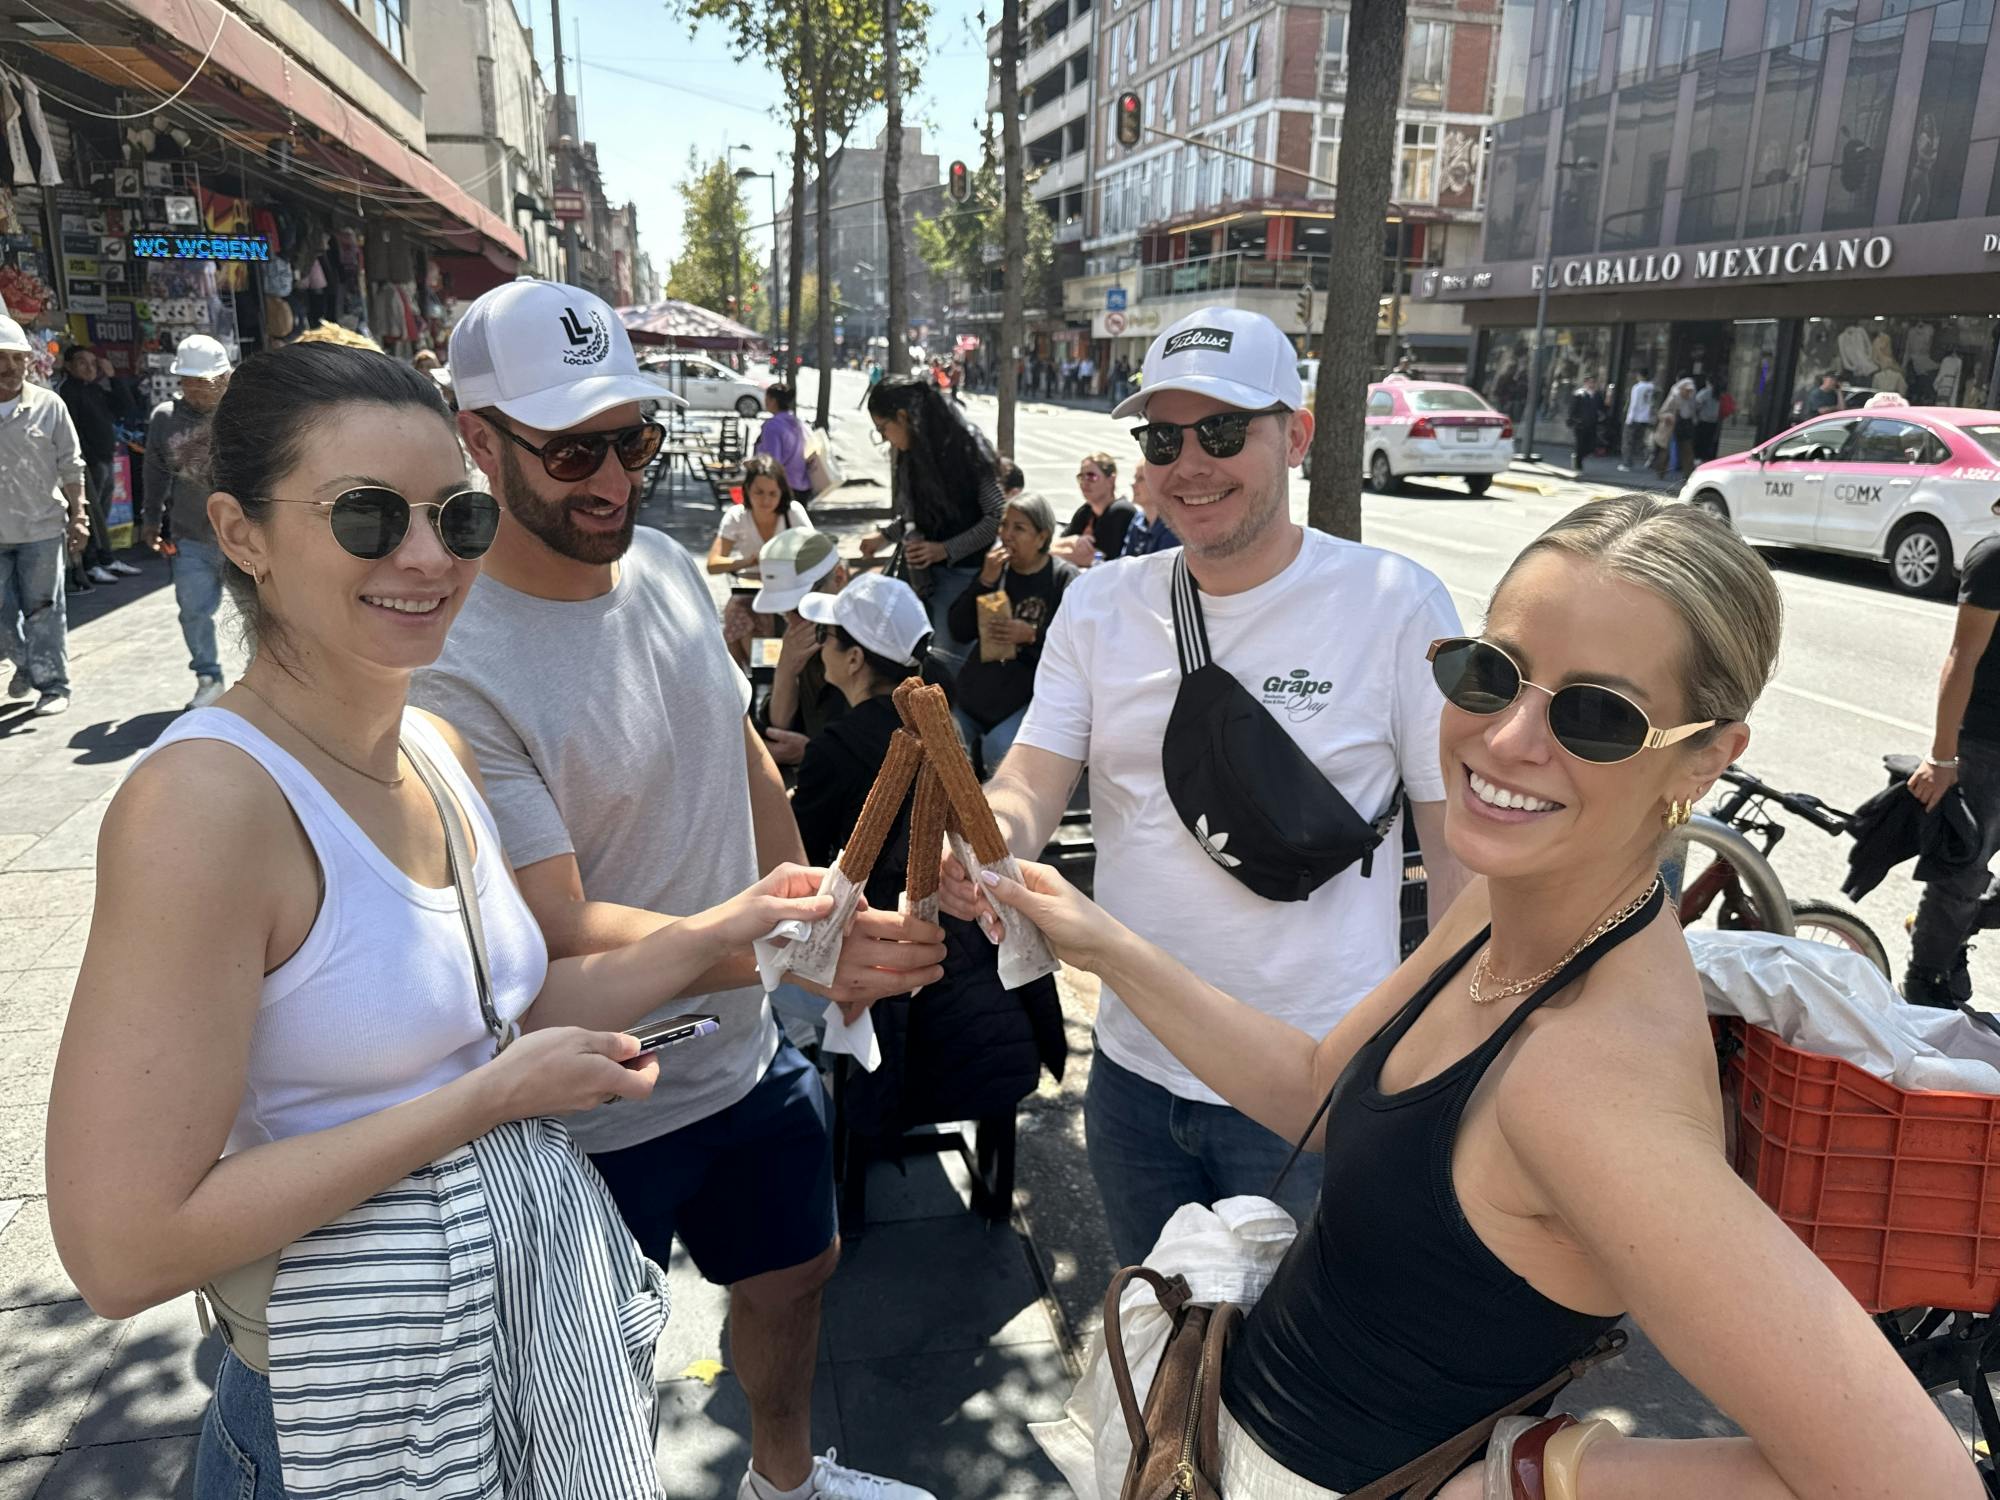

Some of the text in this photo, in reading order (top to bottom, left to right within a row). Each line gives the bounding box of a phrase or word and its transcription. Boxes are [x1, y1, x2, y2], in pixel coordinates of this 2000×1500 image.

[1531, 264, 1559, 289] EL
[1564, 252, 1682, 287] CABALLO
[1694, 236, 1892, 279] MEXICANO
[1165, 330, 1229, 354] Titleist
[563, 356, 593, 365] LOCAL
[1764, 481, 1794, 497] TAXI
[1834, 483, 1882, 502] CDMX
[1263, 676, 1333, 697] Grape
[1284, 694, 1329, 723] Day
